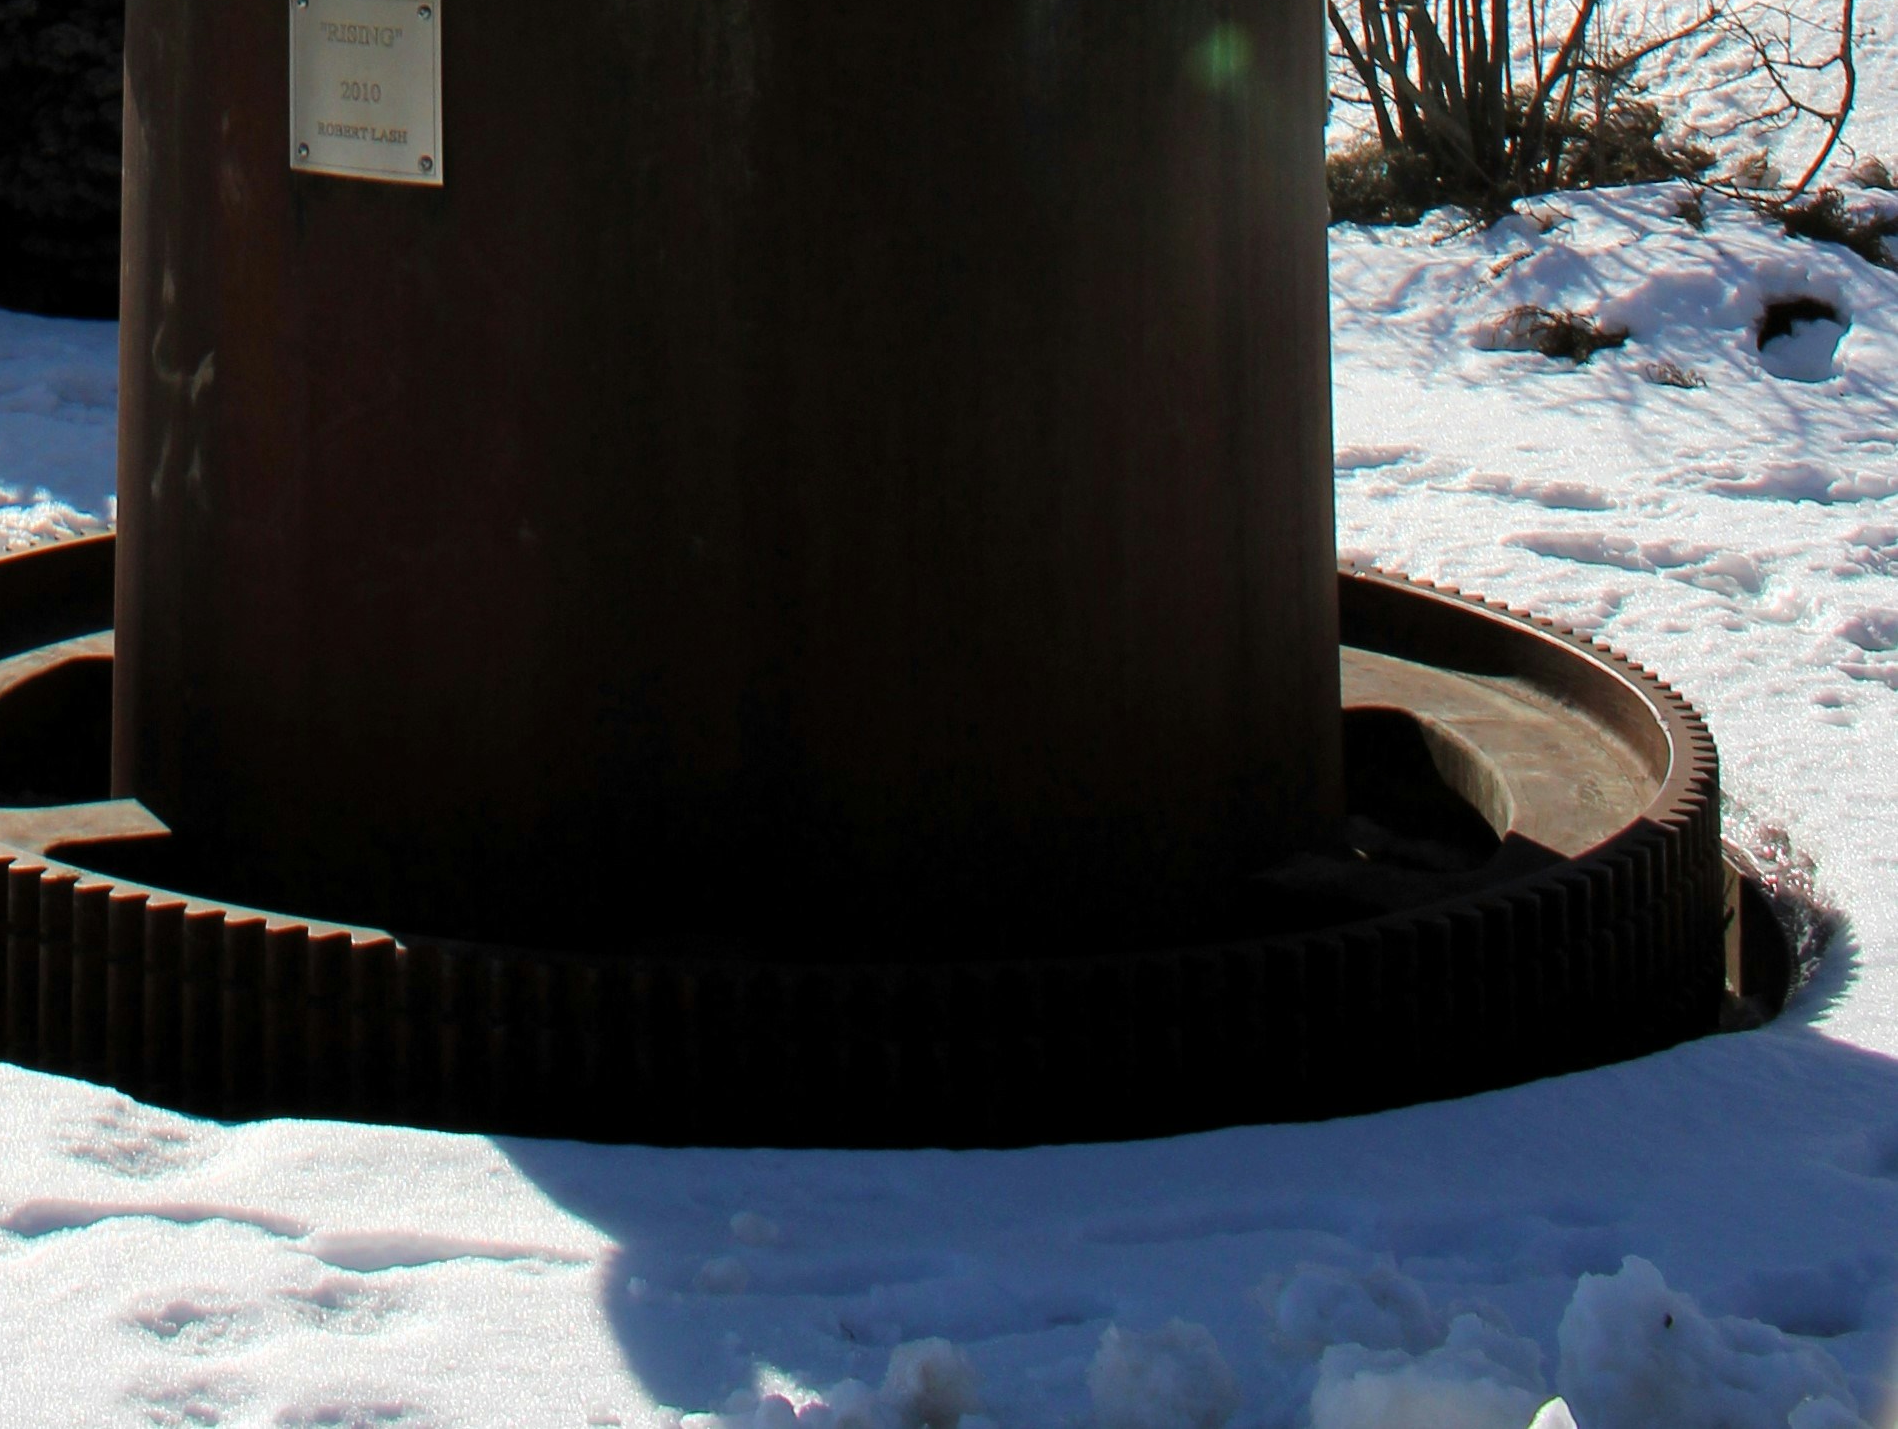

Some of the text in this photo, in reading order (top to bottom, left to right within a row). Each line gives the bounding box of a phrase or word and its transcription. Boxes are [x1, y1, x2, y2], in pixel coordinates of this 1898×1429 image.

[320, 22, 403, 48] "RISING"
[340, 80, 382, 104] 2010
[317, 121, 408, 144] ROBERT LASH
